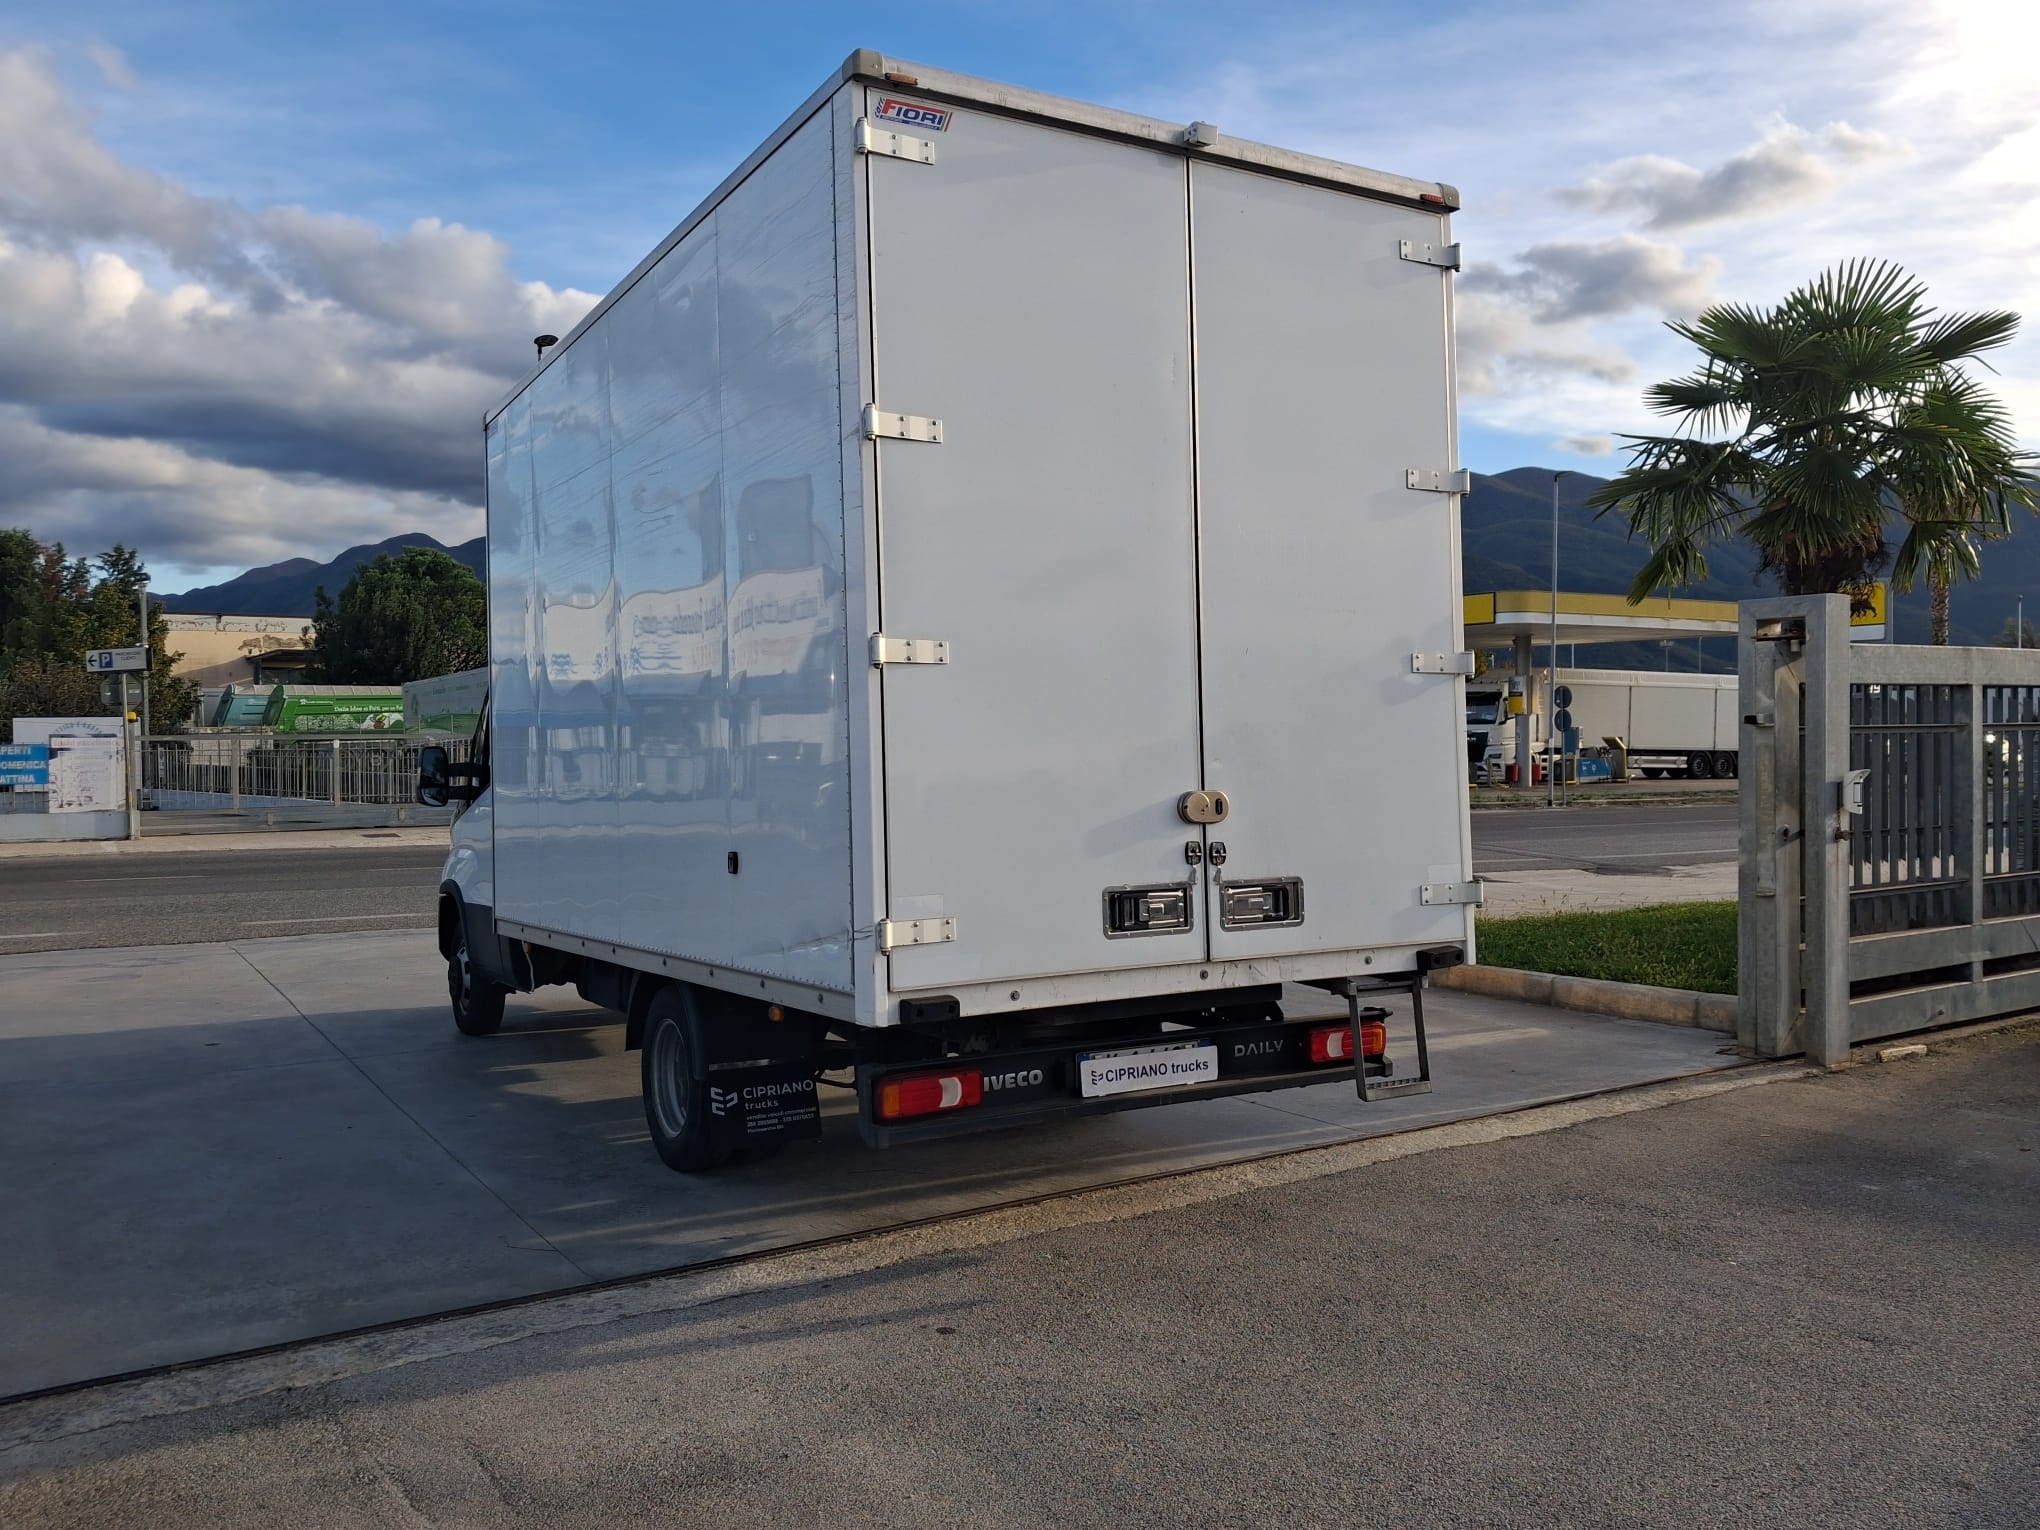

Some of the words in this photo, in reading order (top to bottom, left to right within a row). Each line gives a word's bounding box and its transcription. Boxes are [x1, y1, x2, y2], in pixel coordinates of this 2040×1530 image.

[881, 98, 945, 126] FIORI
[0, 745, 32, 755] PERTI
[0, 760, 46, 769] OMENICA
[1234, 1040, 1284, 1056] DAILY
[1105, 1061, 1168, 1082] CIPRIANO
[1171, 1058, 1209, 1075] trucks
[743, 1079, 814, 1099] CIPRIANO
[983, 1069, 1043, 1092] IVECO
[745, 1099, 780, 1110] trucks
